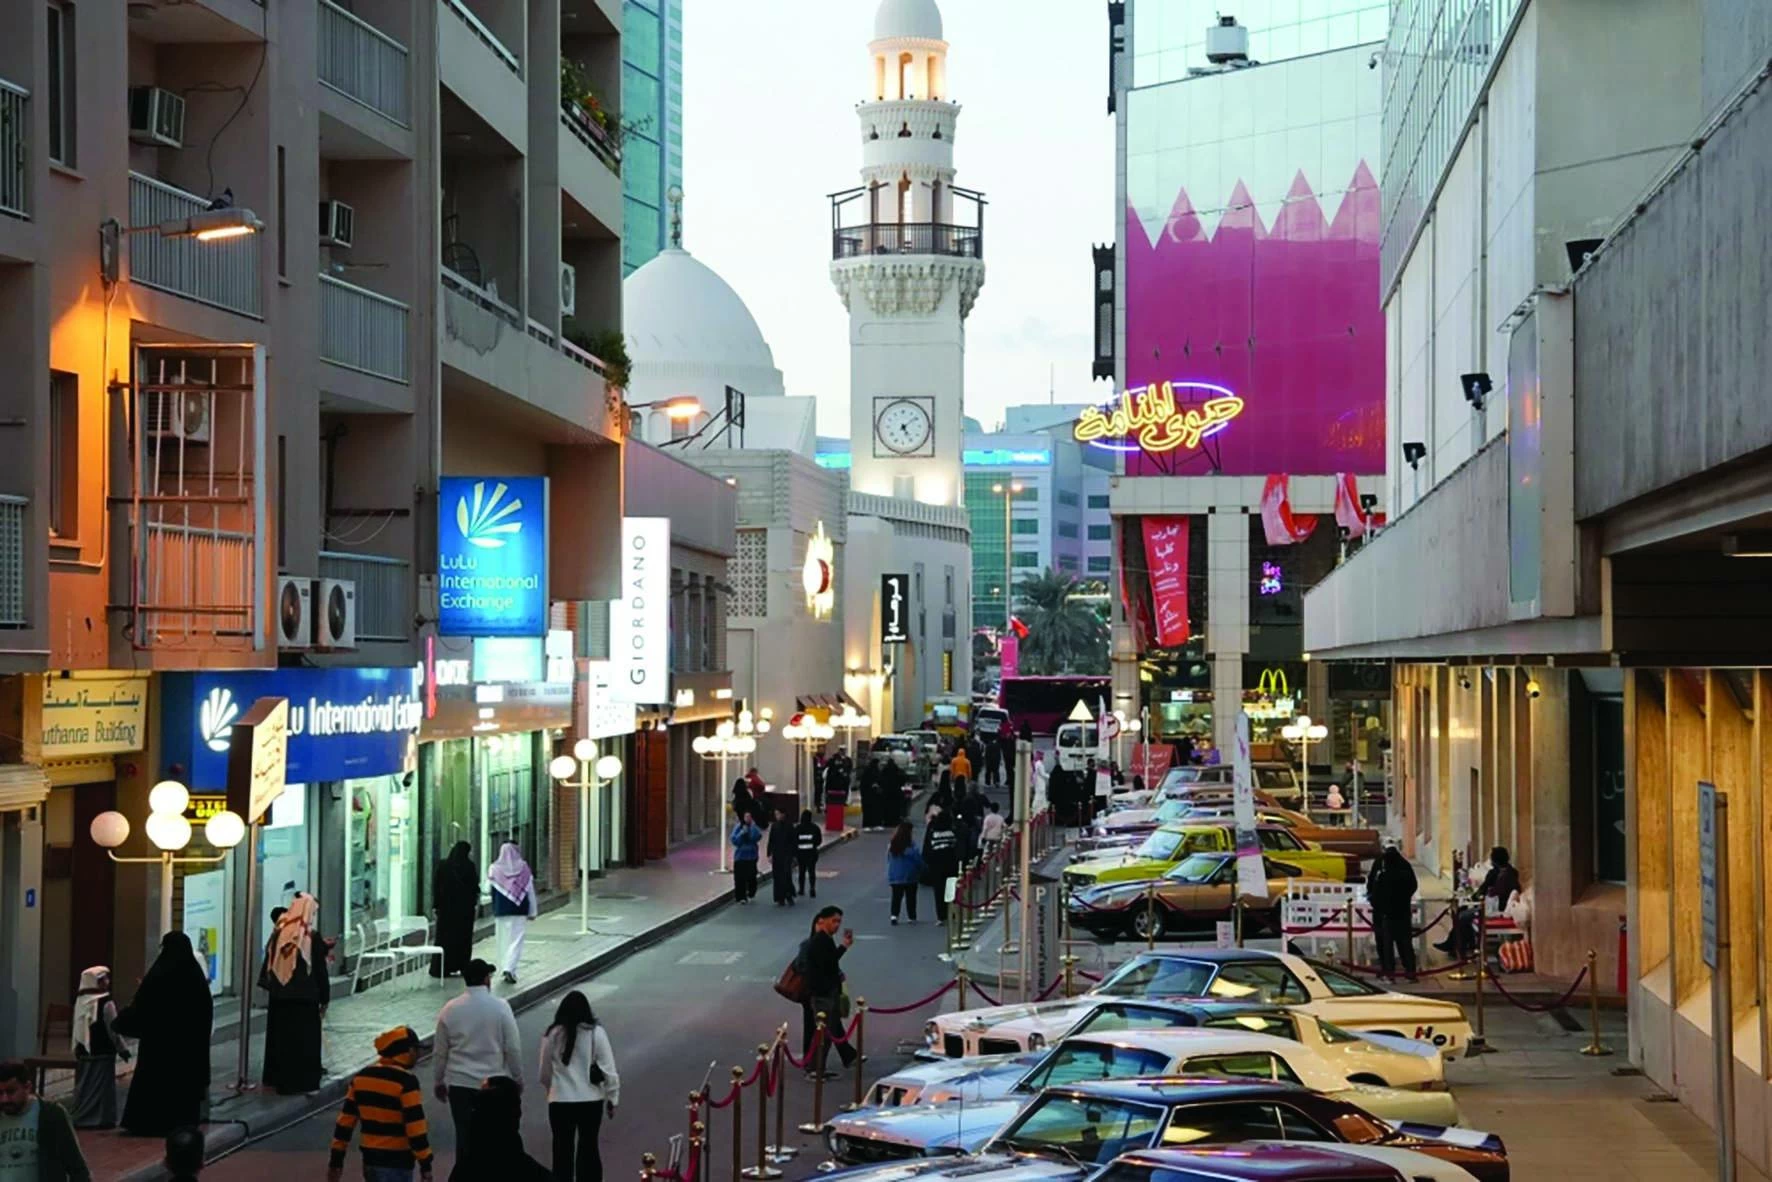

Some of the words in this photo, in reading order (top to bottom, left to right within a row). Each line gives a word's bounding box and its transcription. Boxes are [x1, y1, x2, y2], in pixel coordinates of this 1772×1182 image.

[1075, 381, 1174, 441] المنامة
[441, 555, 478, 570] LuLu
[441, 573, 539, 589] International
[441, 592, 514, 613] Exchange
[630, 535, 647, 685] GIORDANO
[308, 696, 395, 736] International
[43, 724, 89, 745] uthanna
[95, 720, 137, 747] Building
[1035, 887, 1046, 903] P
